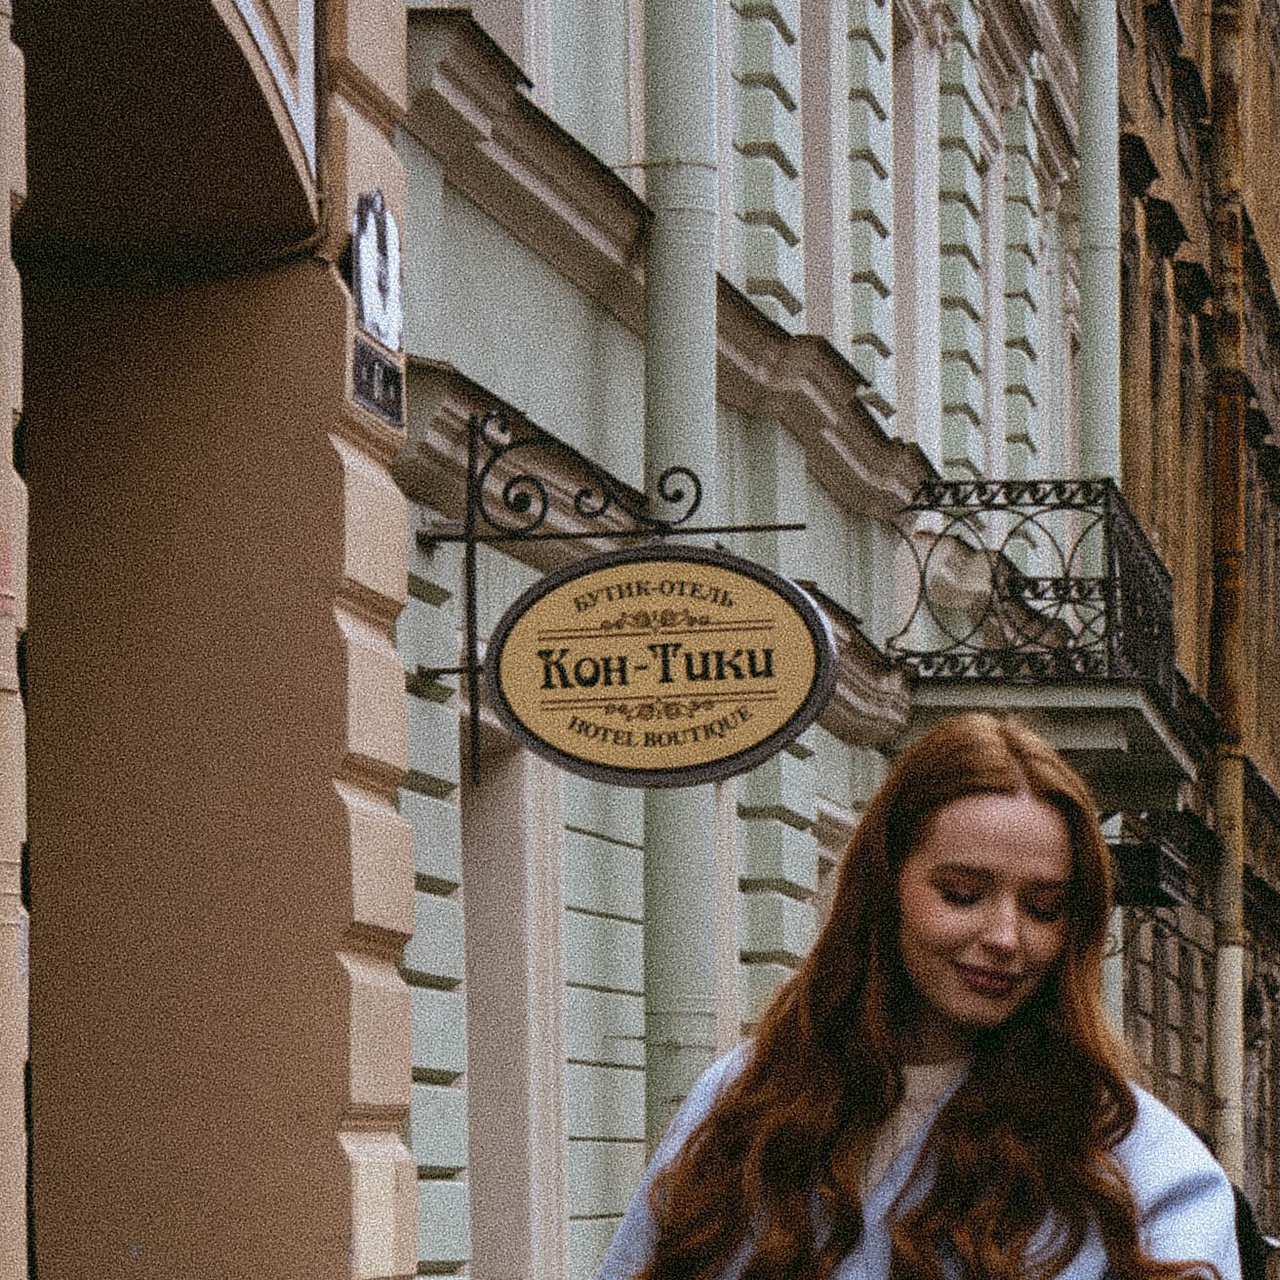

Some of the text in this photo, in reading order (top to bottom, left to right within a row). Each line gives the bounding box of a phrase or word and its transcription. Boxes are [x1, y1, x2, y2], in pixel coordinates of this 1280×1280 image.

[574, 580, 734, 612] БУТИК-ОТЕЛЬ
[537, 643, 775, 689] Кон-Тики
[567, 707, 753, 748] HOTEL BOUTIQUE
